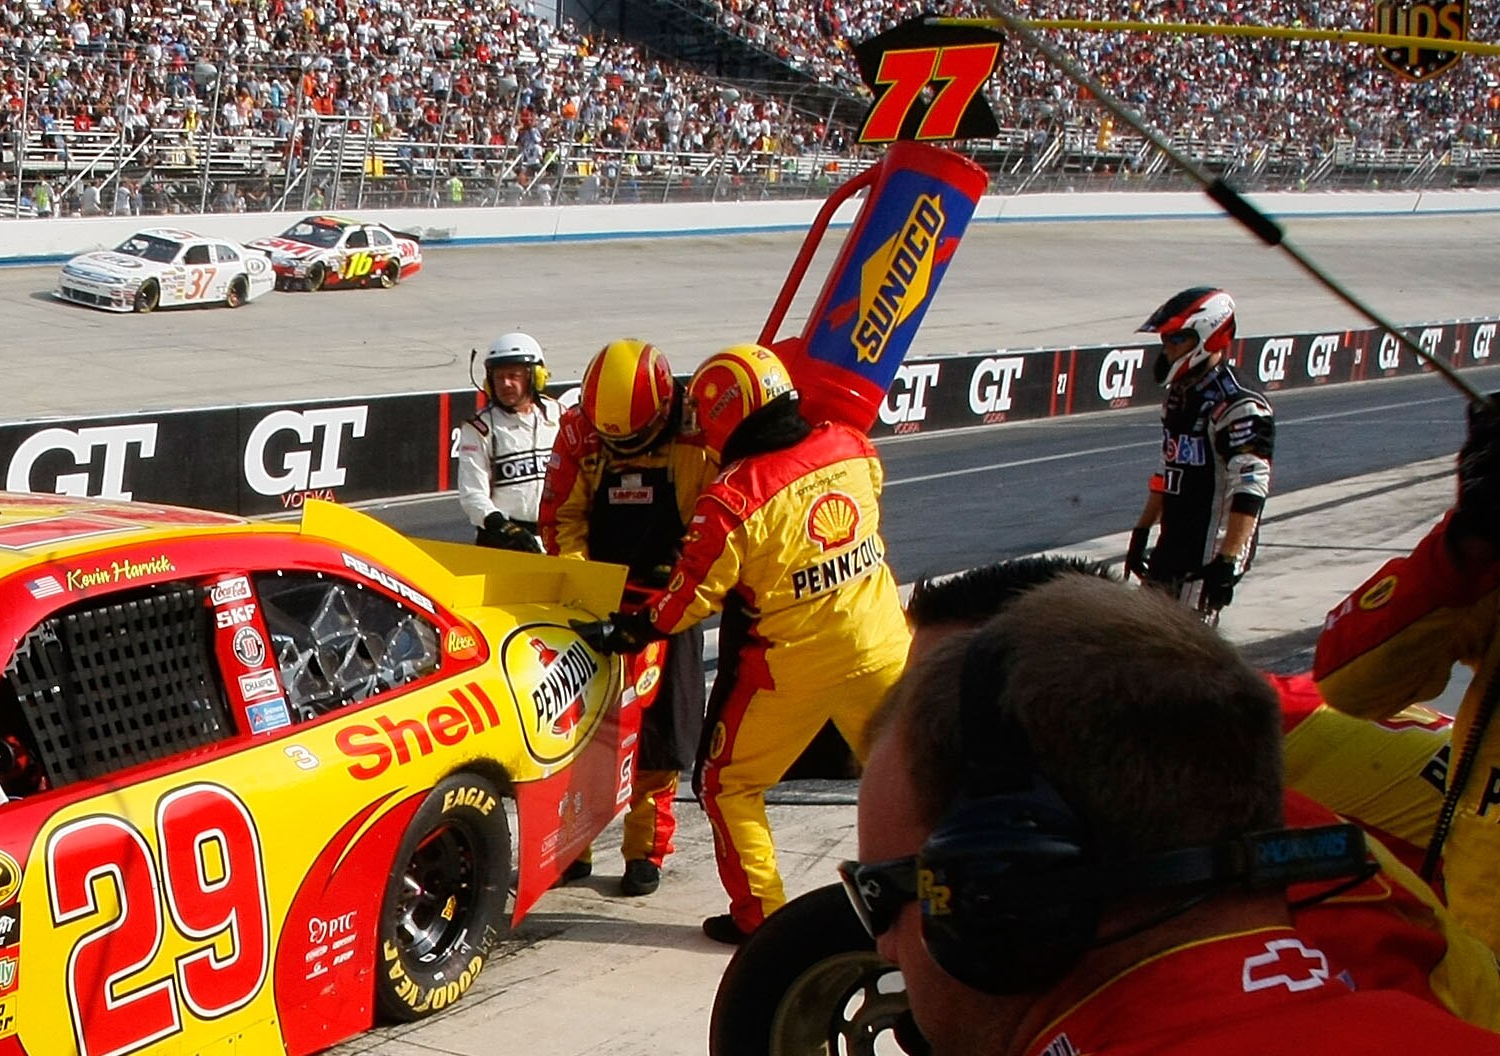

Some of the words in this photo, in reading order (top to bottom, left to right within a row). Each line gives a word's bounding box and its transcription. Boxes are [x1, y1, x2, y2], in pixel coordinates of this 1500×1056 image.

[858, 42, 1000, 143] 77
[185, 267, 218, 299] 37
[344, 252, 373, 279] 16
[855, 197, 942, 358] SUNOCO
[1258, 338, 1294, 382] GT
[1307, 335, 1340, 377] GT
[1473, 324, 1498, 360] GT
[878, 363, 940, 425] GT
[969, 357, 1025, 415] GT
[1098, 349, 1145, 400] GT
[6, 422, 159, 502] GT
[244, 405, 369, 496] GT
[1164, 429, 1206, 466] obil
[281, 489, 336, 509] VODKA
[66, 567, 111, 591] Kevin
[341, 551, 436, 615] REALTREE
[792, 535, 884, 599] PENNZOIL
[216, 603, 255, 629] SKF
[531, 640, 598, 734] PENNZOIL
[335, 680, 501, 781] Shell
[283, 744, 320, 771] 3
[441, 786, 496, 817] EAGLE
